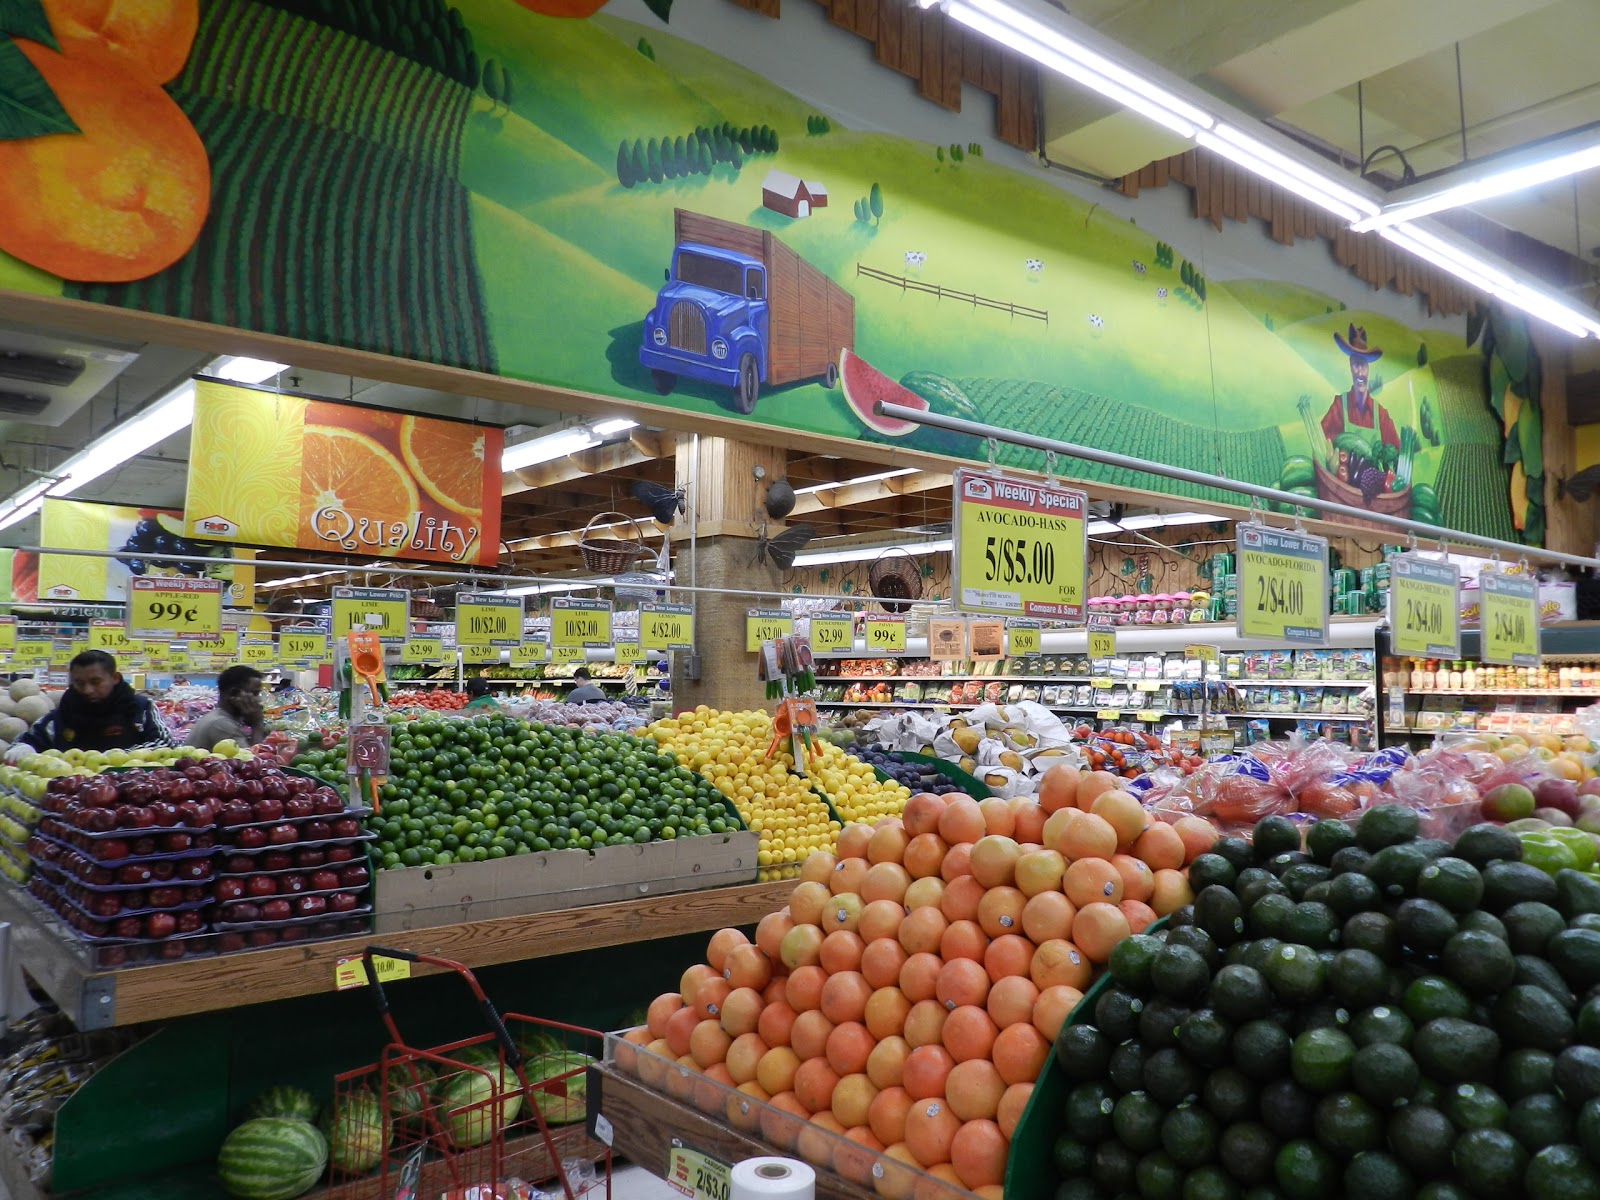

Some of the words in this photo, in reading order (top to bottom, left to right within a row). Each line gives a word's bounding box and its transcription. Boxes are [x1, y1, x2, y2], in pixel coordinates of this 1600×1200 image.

[994, 482, 1036, 507] Weekly
[1039, 488, 1079, 510] Special
[977, 511, 1067, 531] AVOCADO-HASS
[310, 506, 477, 561] Quality
[1263, 534, 1278, 546] New
[1280, 538, 1300, 550] Lower
[1302, 542, 1319, 552] Price
[985, 536, 1055, 586] 5/$5.00
[1245, 553, 1316, 572] AVOCADO-FLORIDA
[156, 579, 186, 589] Weekly
[188, 580, 218, 589] Special
[1058, 586, 1076, 595] FOR
[1258, 576, 1303, 616] 2/$4.00
[149, 602, 198, 625] 99¢
[1029, 602, 1056, 614] Compare
[1058, 604, 1062, 614] &
[1063, 606, 1078, 616] Save
[1406, 598, 1442, 634] 2/$4.00
[349, 612, 390, 630] 10/.00
[470, 617, 506, 634] 10/$2.00
[565, 620, 598, 636] 10/$2.00
[652, 621, 681, 639] 4/$2.00
[756, 627, 782, 640] 4/$2.00
[819, 629, 843, 643] $2.99
[874, 630, 896, 644] 99¢
[1287, 628, 1305, 638] Compare
[100, 634, 130, 646] $1.99
[289, 640, 314, 652] $1.99
[1015, 636, 1033, 648] $6.99
[1094, 640, 1110, 652] $1.29
[247, 650, 266, 658] $2.99
[410, 645, 432, 655] $2.99
[471, 647, 492, 657] $2.99
[518, 646, 538, 657] $2.99
[559, 648, 577, 657] $2.99
[622, 648, 639, 658] $3.99
[374, 960, 394, 974] 10.00
[697, 1168, 730, 1200] 2/$3.0
